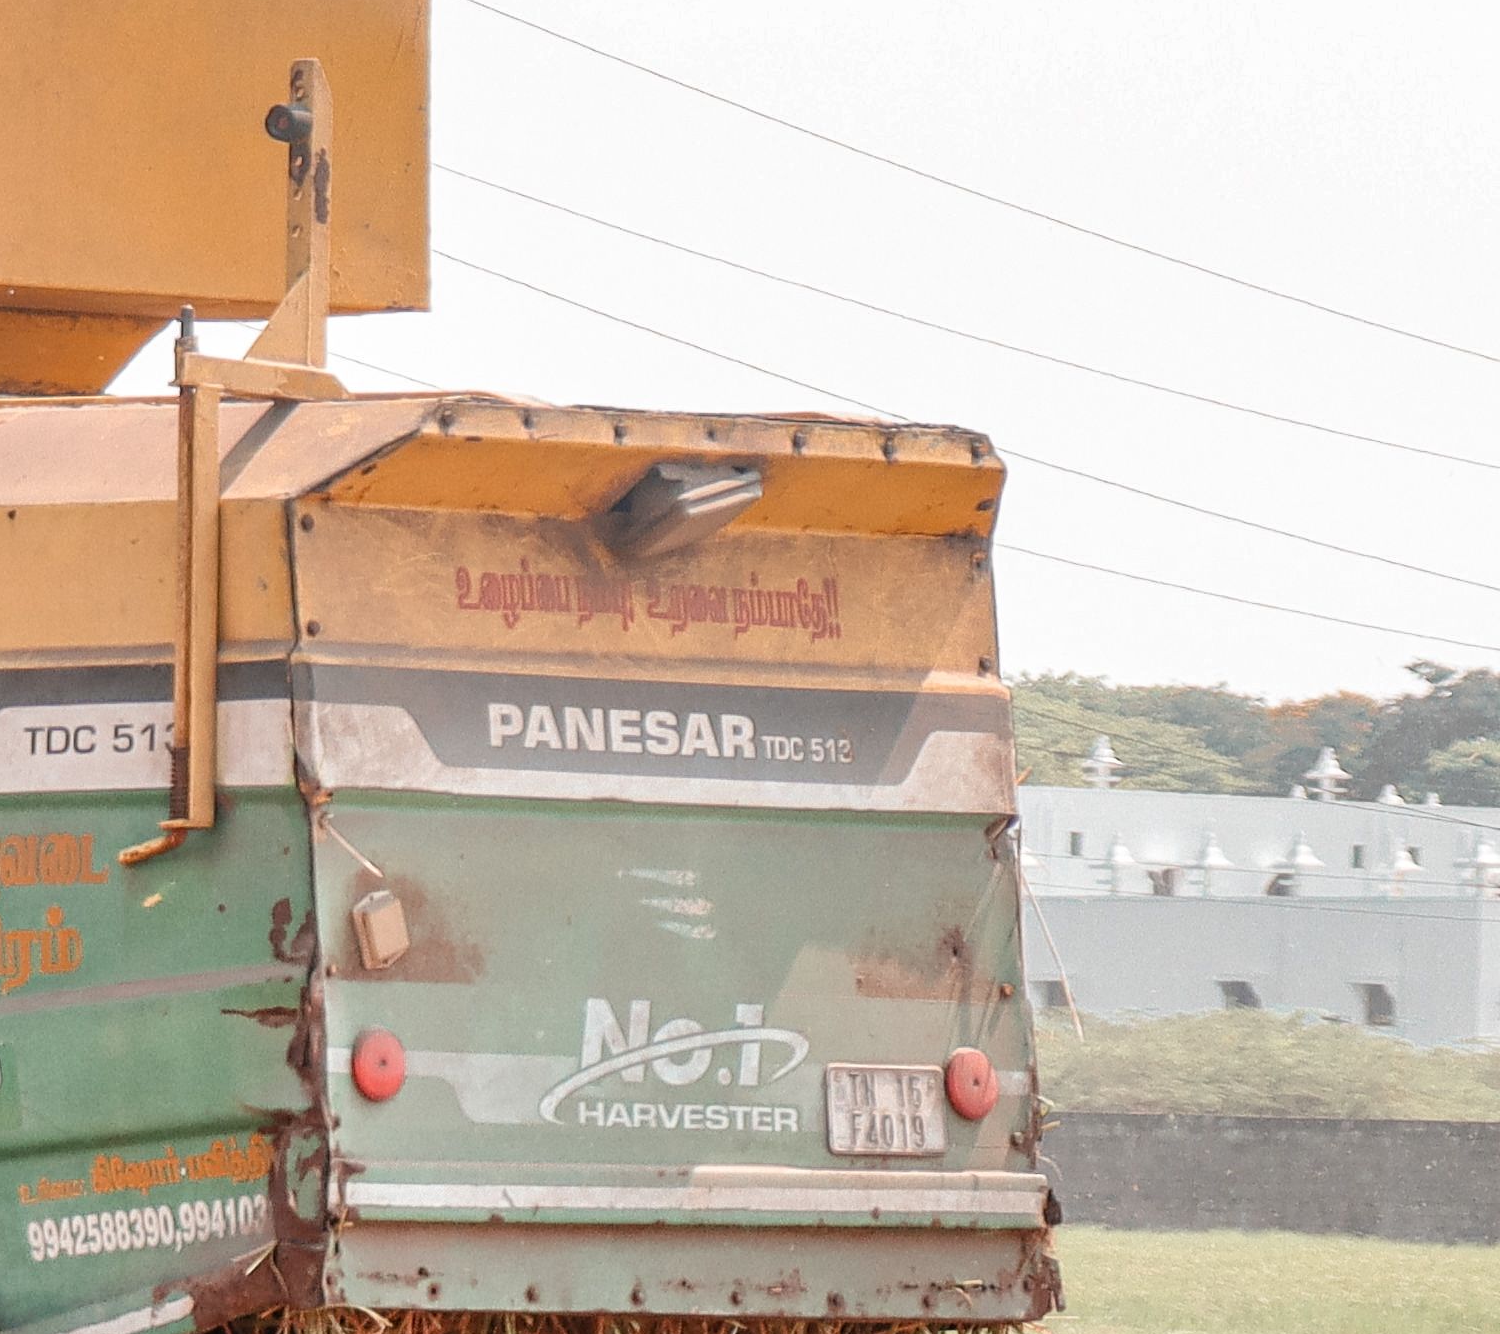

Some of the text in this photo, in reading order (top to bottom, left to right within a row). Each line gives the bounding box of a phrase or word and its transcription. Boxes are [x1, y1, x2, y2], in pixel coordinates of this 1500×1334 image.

[24, 724, 97, 756] TDC
[487, 702, 854, 765] PANESAR TDC 513
[577, 1100, 800, 1133] HARVESTER
